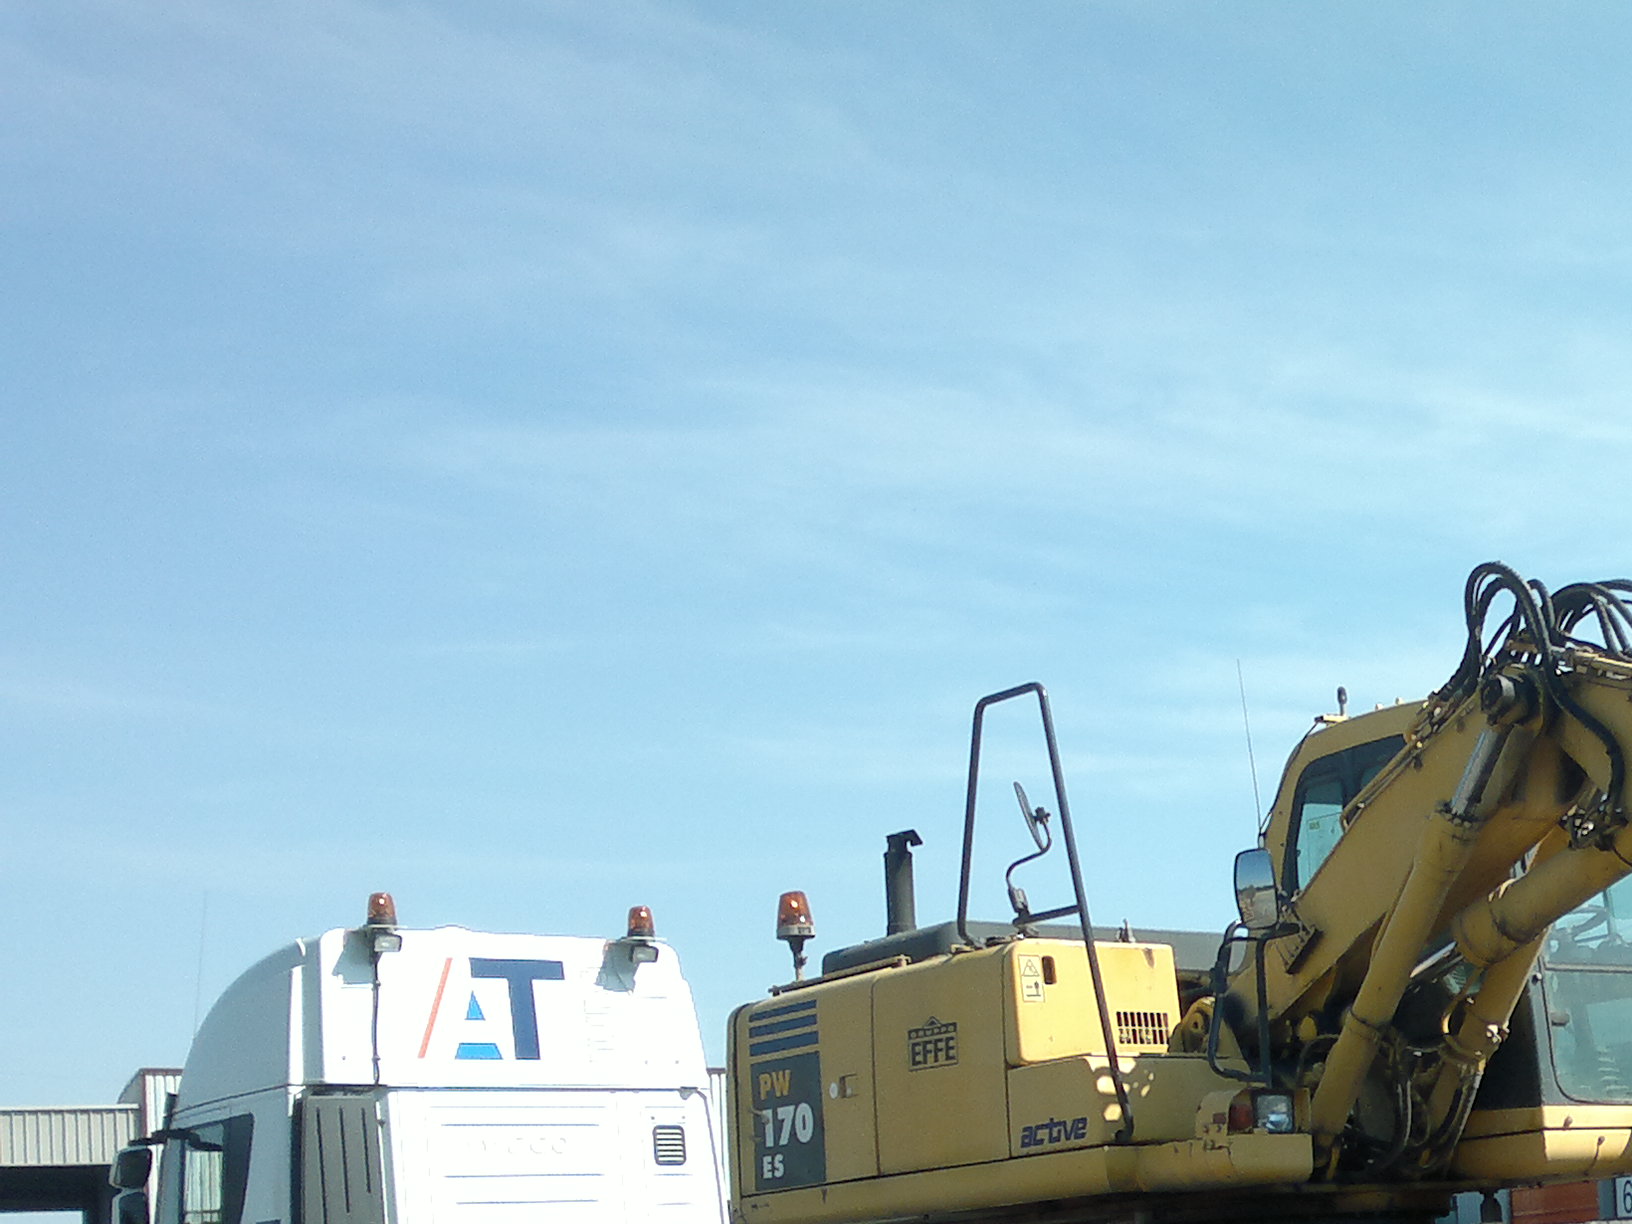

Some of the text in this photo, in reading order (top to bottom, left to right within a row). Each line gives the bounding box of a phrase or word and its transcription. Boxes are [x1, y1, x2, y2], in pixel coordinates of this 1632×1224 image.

[417, 957, 565, 1060] AT
[911, 1036, 956, 1067] EFFE
[759, 1069, 791, 1100] PW
[761, 1102, 814, 1148] 170
[763, 1153, 784, 1179] ES
